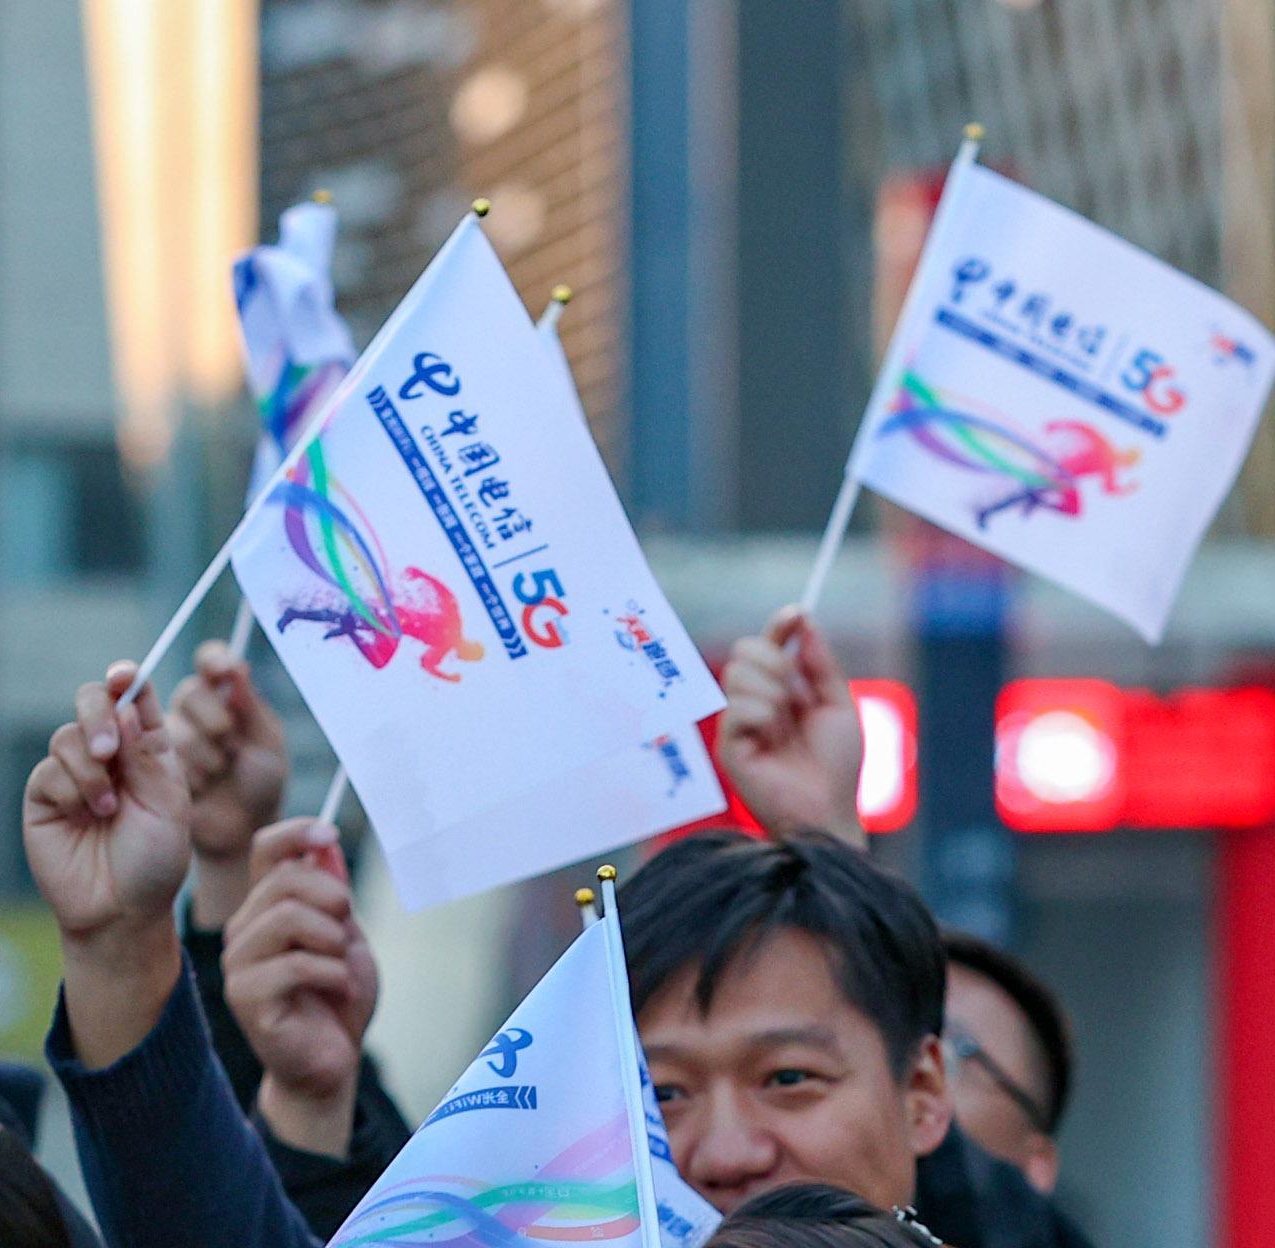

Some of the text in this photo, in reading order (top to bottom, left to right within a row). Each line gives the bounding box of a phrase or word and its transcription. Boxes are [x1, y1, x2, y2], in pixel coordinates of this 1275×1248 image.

[1120, 348, 1183, 412] 5G
[420, 424, 495, 549] CHINA TELECOM
[441, 410, 532, 540] 中国电信
[511, 568, 566, 647] 5G
